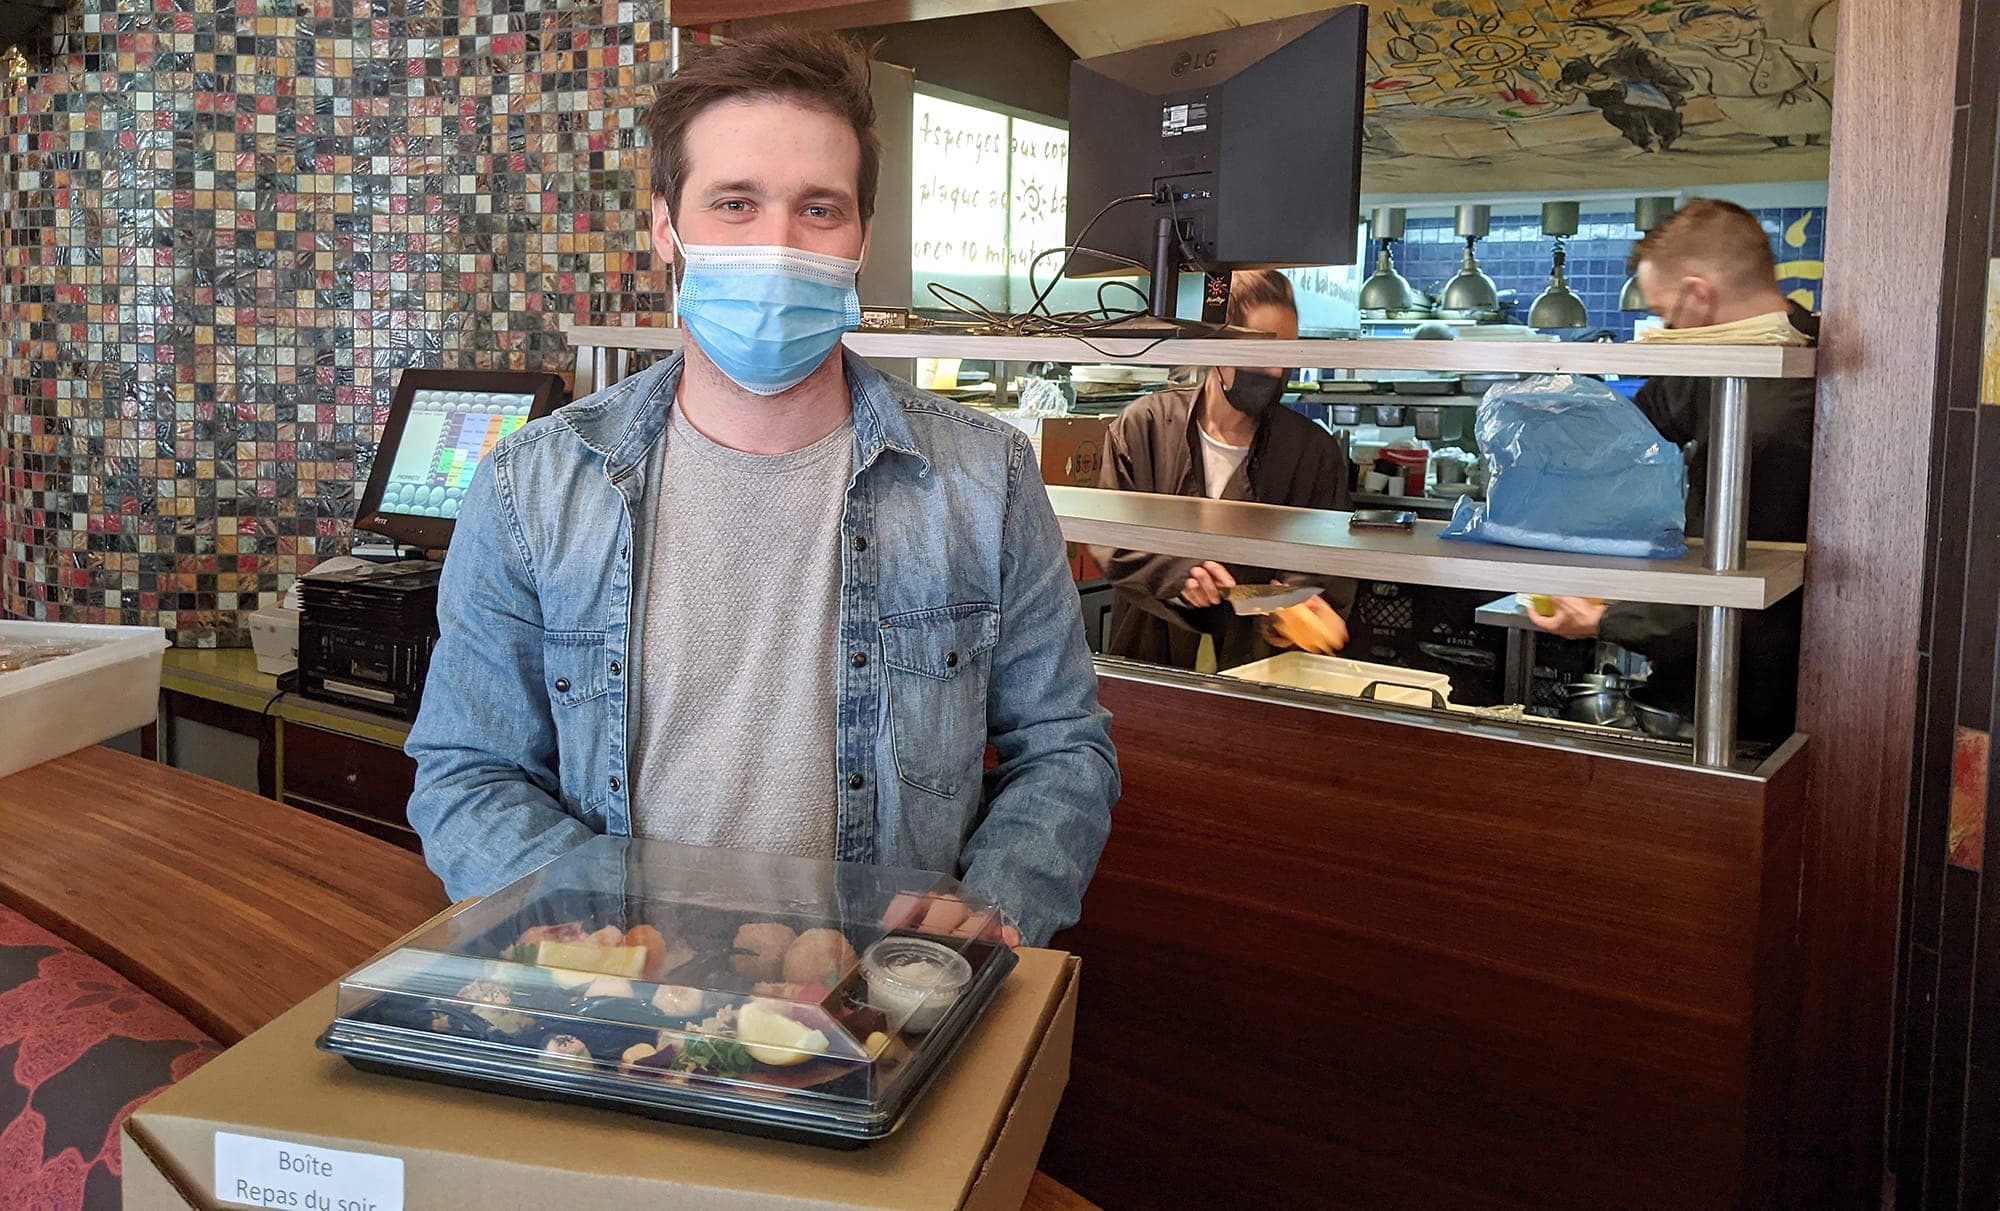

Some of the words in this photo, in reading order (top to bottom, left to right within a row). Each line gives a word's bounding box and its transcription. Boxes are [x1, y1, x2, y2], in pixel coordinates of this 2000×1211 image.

[1193, 49, 1217, 71] LG
[1011, 137, 1037, 159] aux
[919, 175, 981, 217] plaque
[961, 239, 978, 263] 10
[279, 1151, 333, 1177] Boîte
[237, 1179, 298, 1206] Repas
[305, 1190, 330, 1211] du
[338, 1198, 377, 1211] soir
